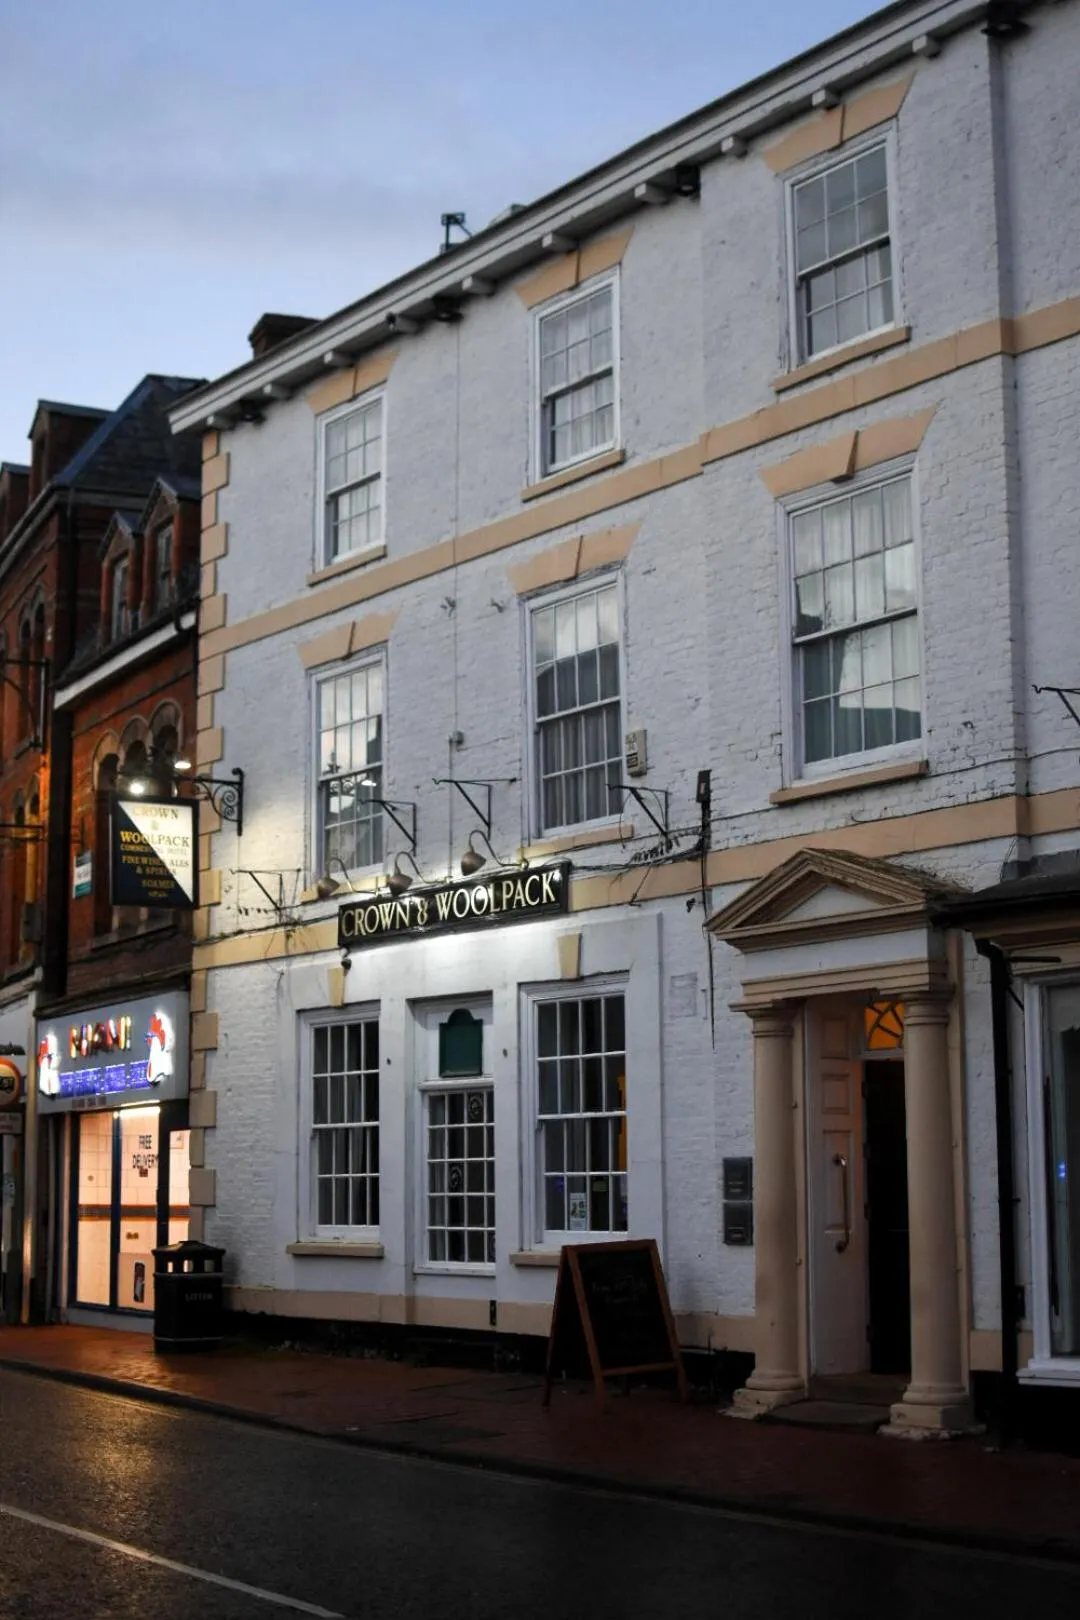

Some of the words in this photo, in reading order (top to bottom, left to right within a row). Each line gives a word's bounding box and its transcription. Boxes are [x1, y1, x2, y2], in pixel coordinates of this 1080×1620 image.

[133, 806, 179, 820] CROWN
[120, 830, 190, 847] WOOLPACK
[146, 866, 177, 876] SPIRIS
[341, 900, 411, 937] CROWN
[417, 899, 429, 926] &
[435, 872, 555, 921] WOOLPACK
[138, 1134, 153, 1150] FREE
[132, 1153, 159, 1170] DELIVERY
